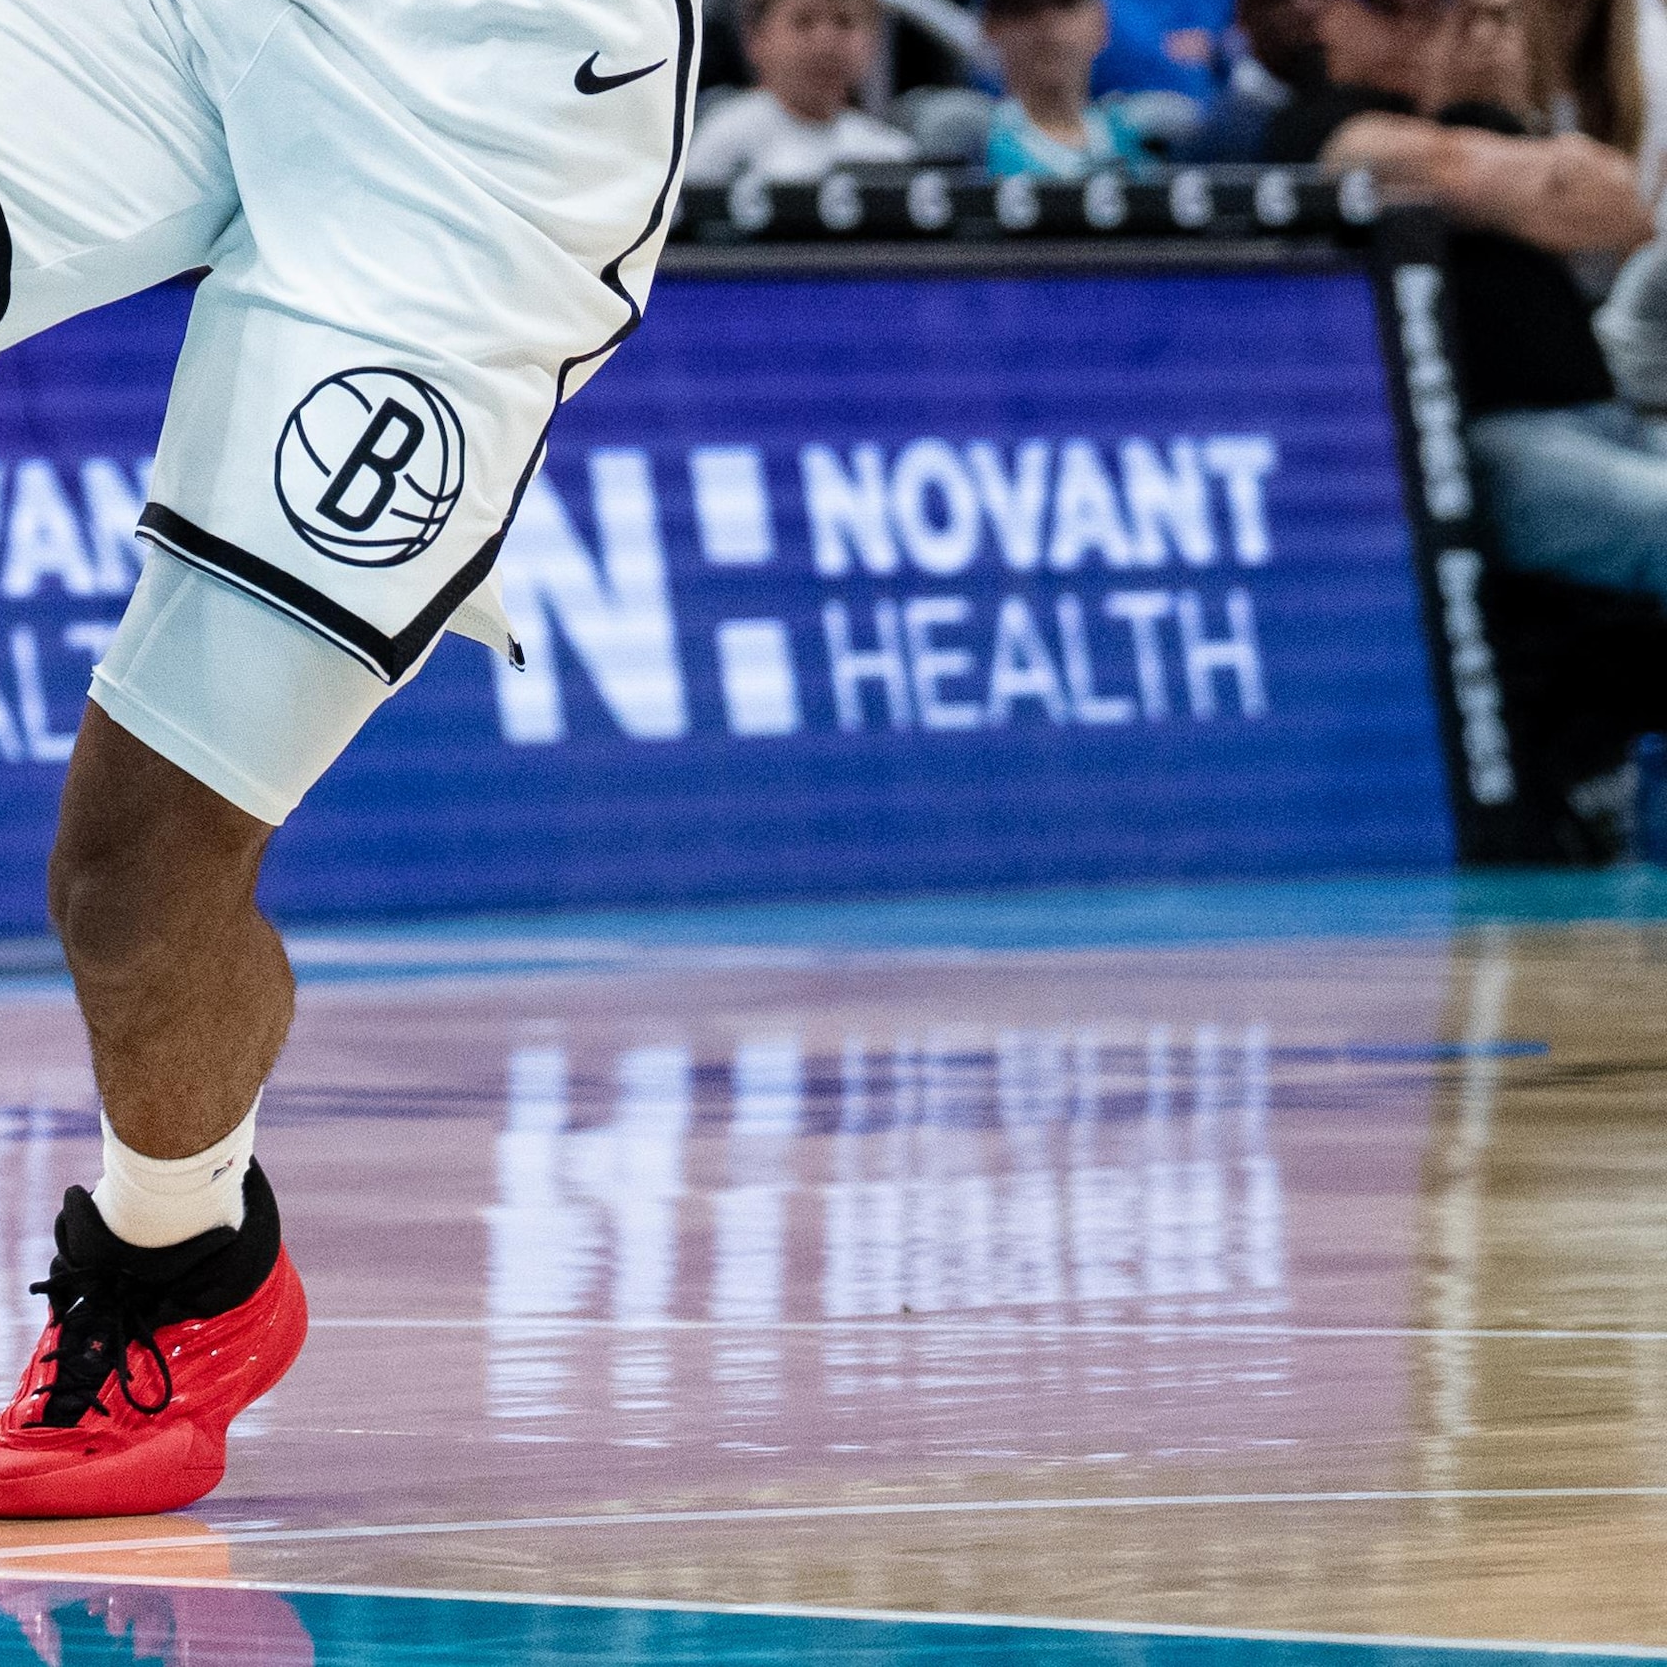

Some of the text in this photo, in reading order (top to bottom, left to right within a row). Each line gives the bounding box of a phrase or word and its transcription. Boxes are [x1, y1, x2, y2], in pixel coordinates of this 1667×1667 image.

[315, 396, 425, 532] B
[801, 436, 1277, 575] NOVANT
[822, 588, 1269, 733] HEALTH
